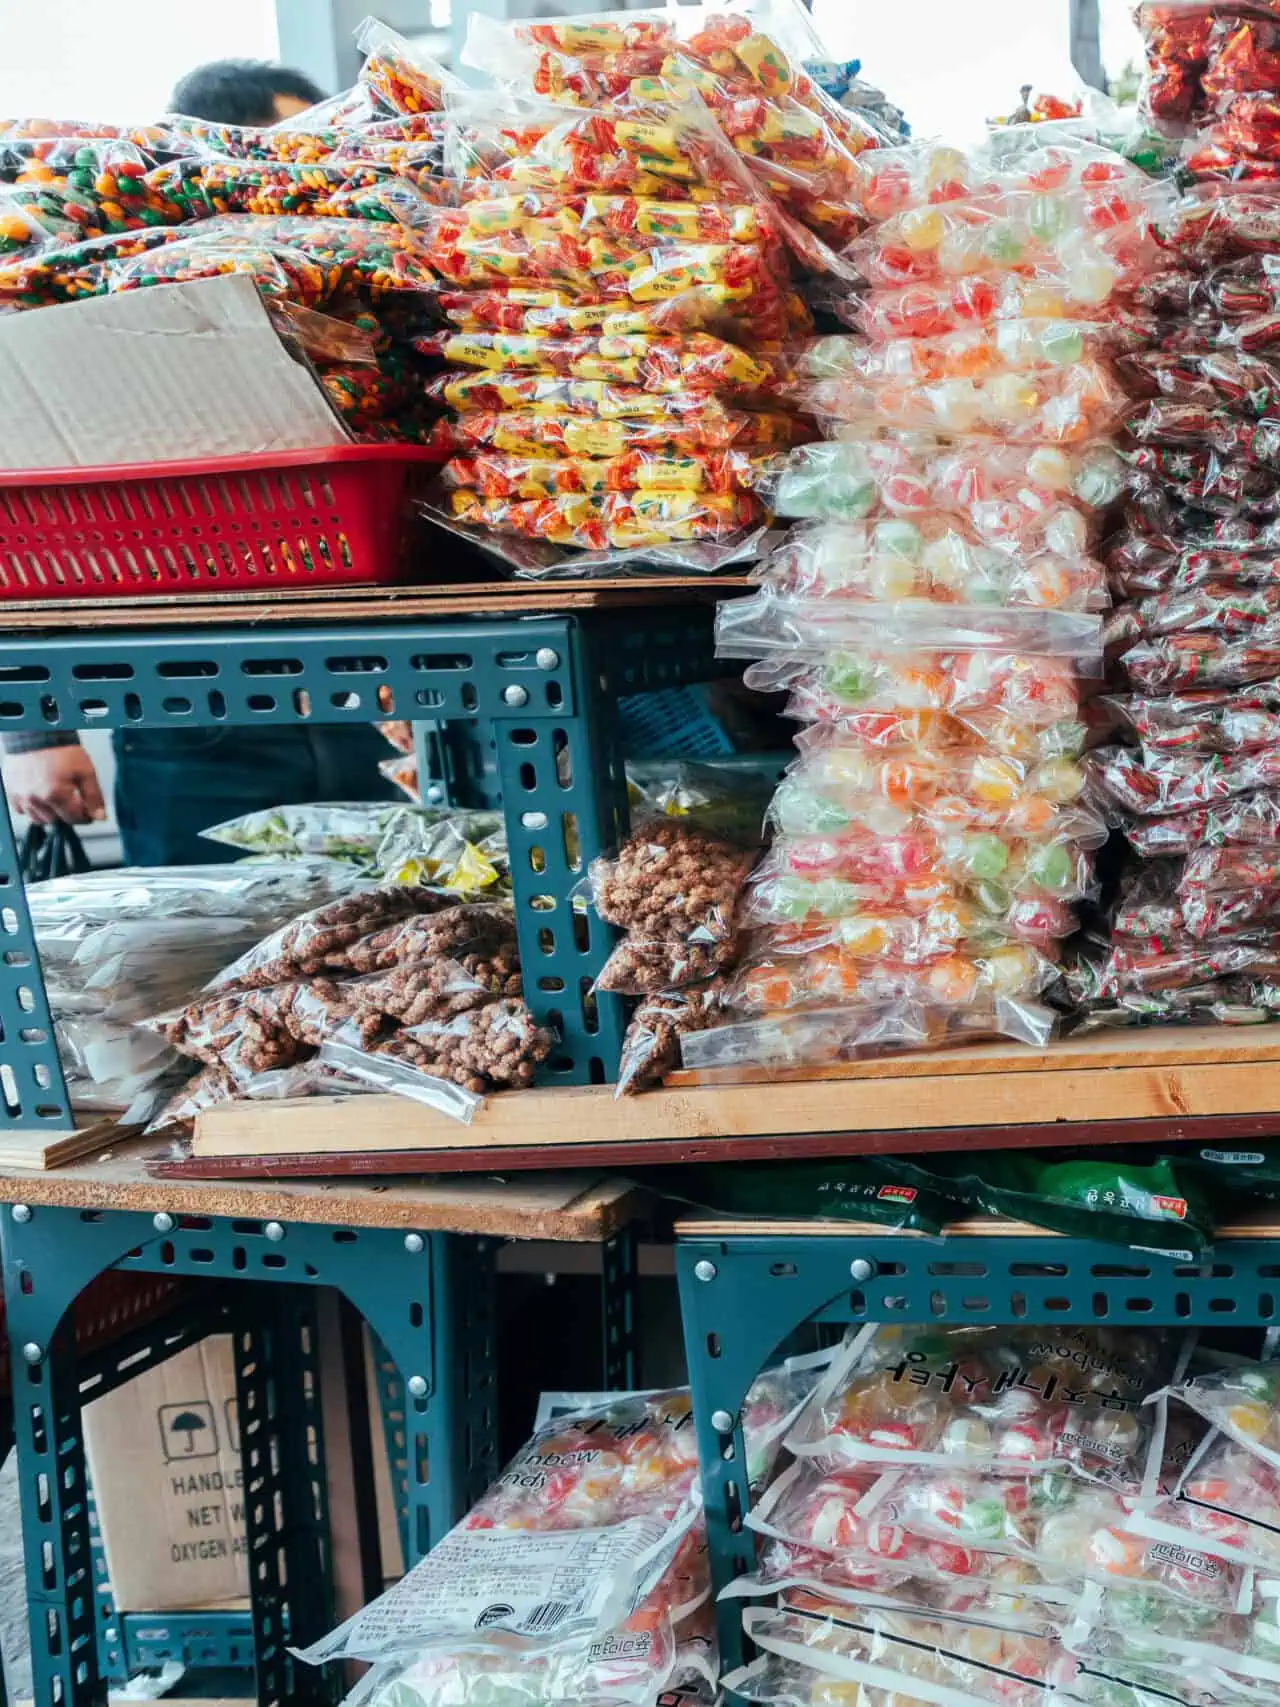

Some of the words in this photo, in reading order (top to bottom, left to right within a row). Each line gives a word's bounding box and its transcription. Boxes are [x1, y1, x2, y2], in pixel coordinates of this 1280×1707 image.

[882, 1351, 988, 1394] 사탕
[990, 1365, 1142, 1412] 무지개
[171, 1470, 246, 1497] HANDLE
[186, 1504, 222, 1528] NET
[170, 1538, 228, 1563] OXYGEN
